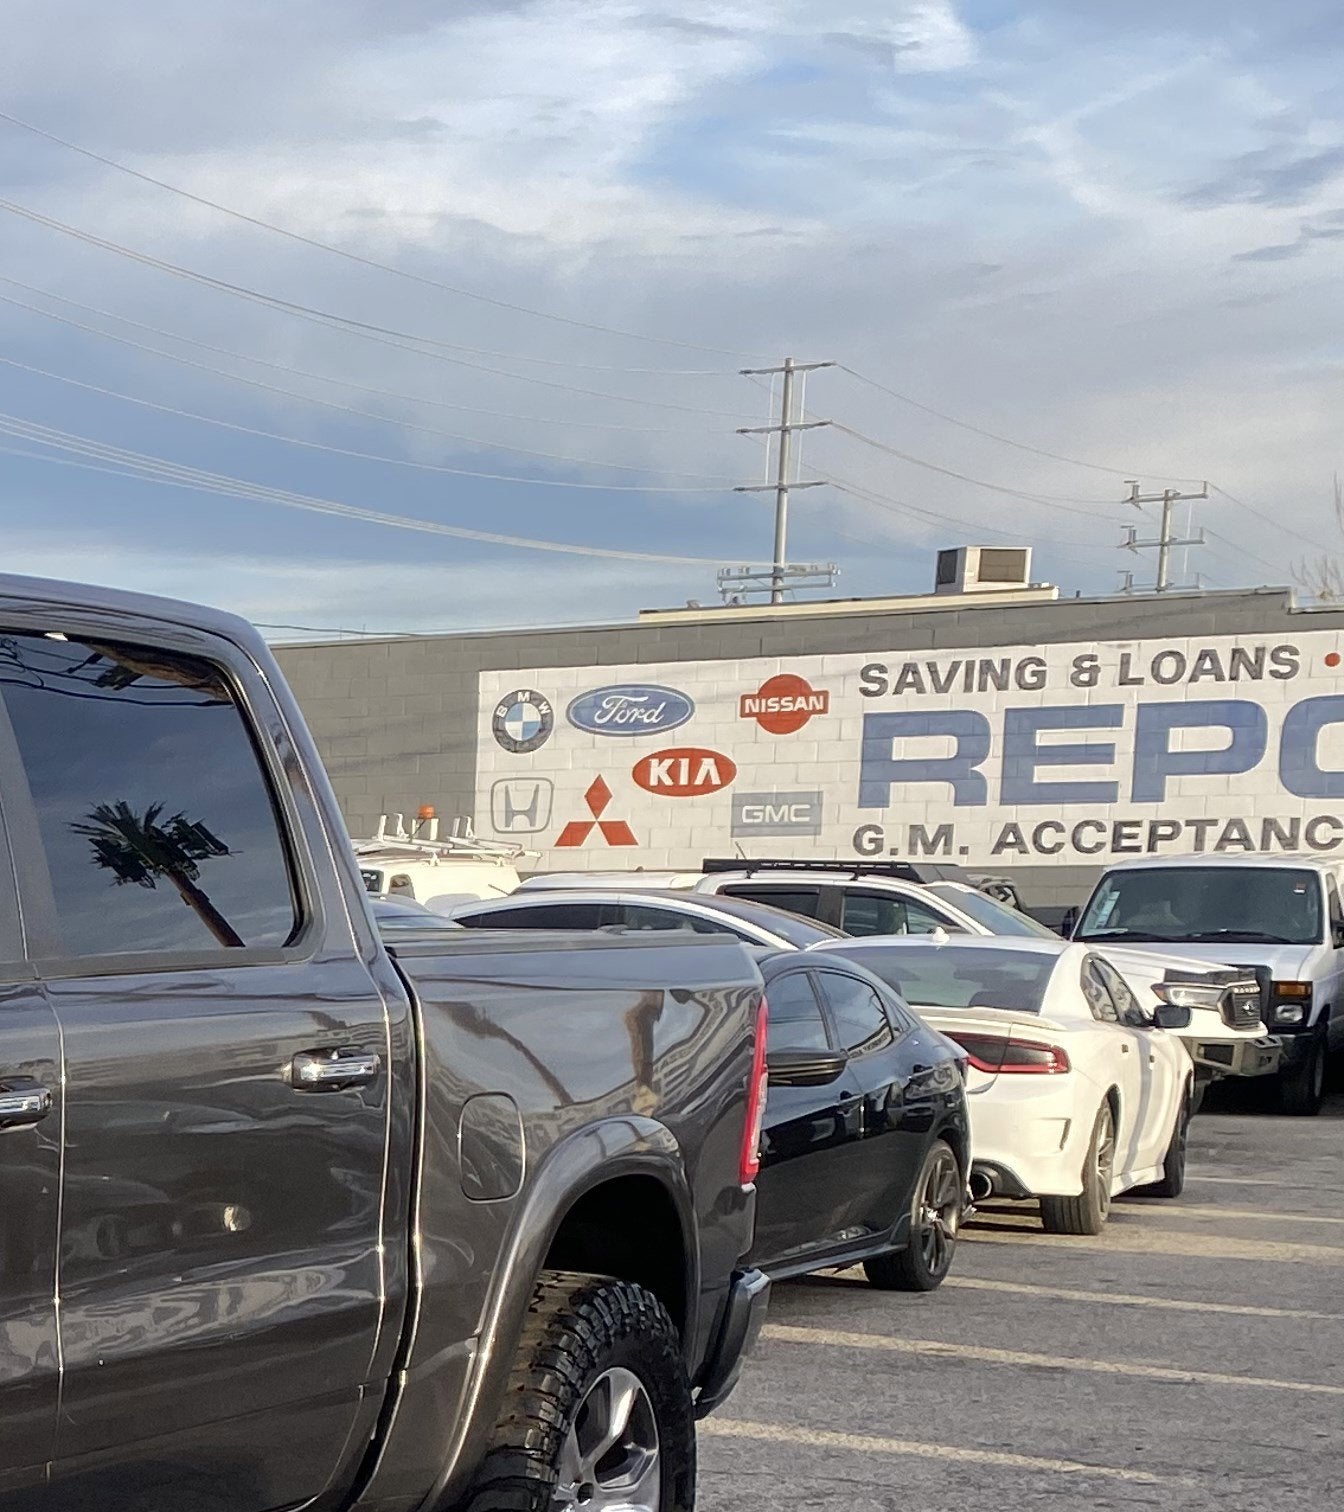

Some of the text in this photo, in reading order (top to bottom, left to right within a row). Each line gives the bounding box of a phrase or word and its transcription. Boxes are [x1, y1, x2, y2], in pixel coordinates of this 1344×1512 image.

[858, 644, 1301, 698] SAVING & LOANS
[593, 694, 667, 725] Ford
[743, 695, 825, 715] NISSAN
[648, 757, 723, 787] KIA
[741, 803, 812, 824] GMC
[852, 823, 969, 857] G.M.
